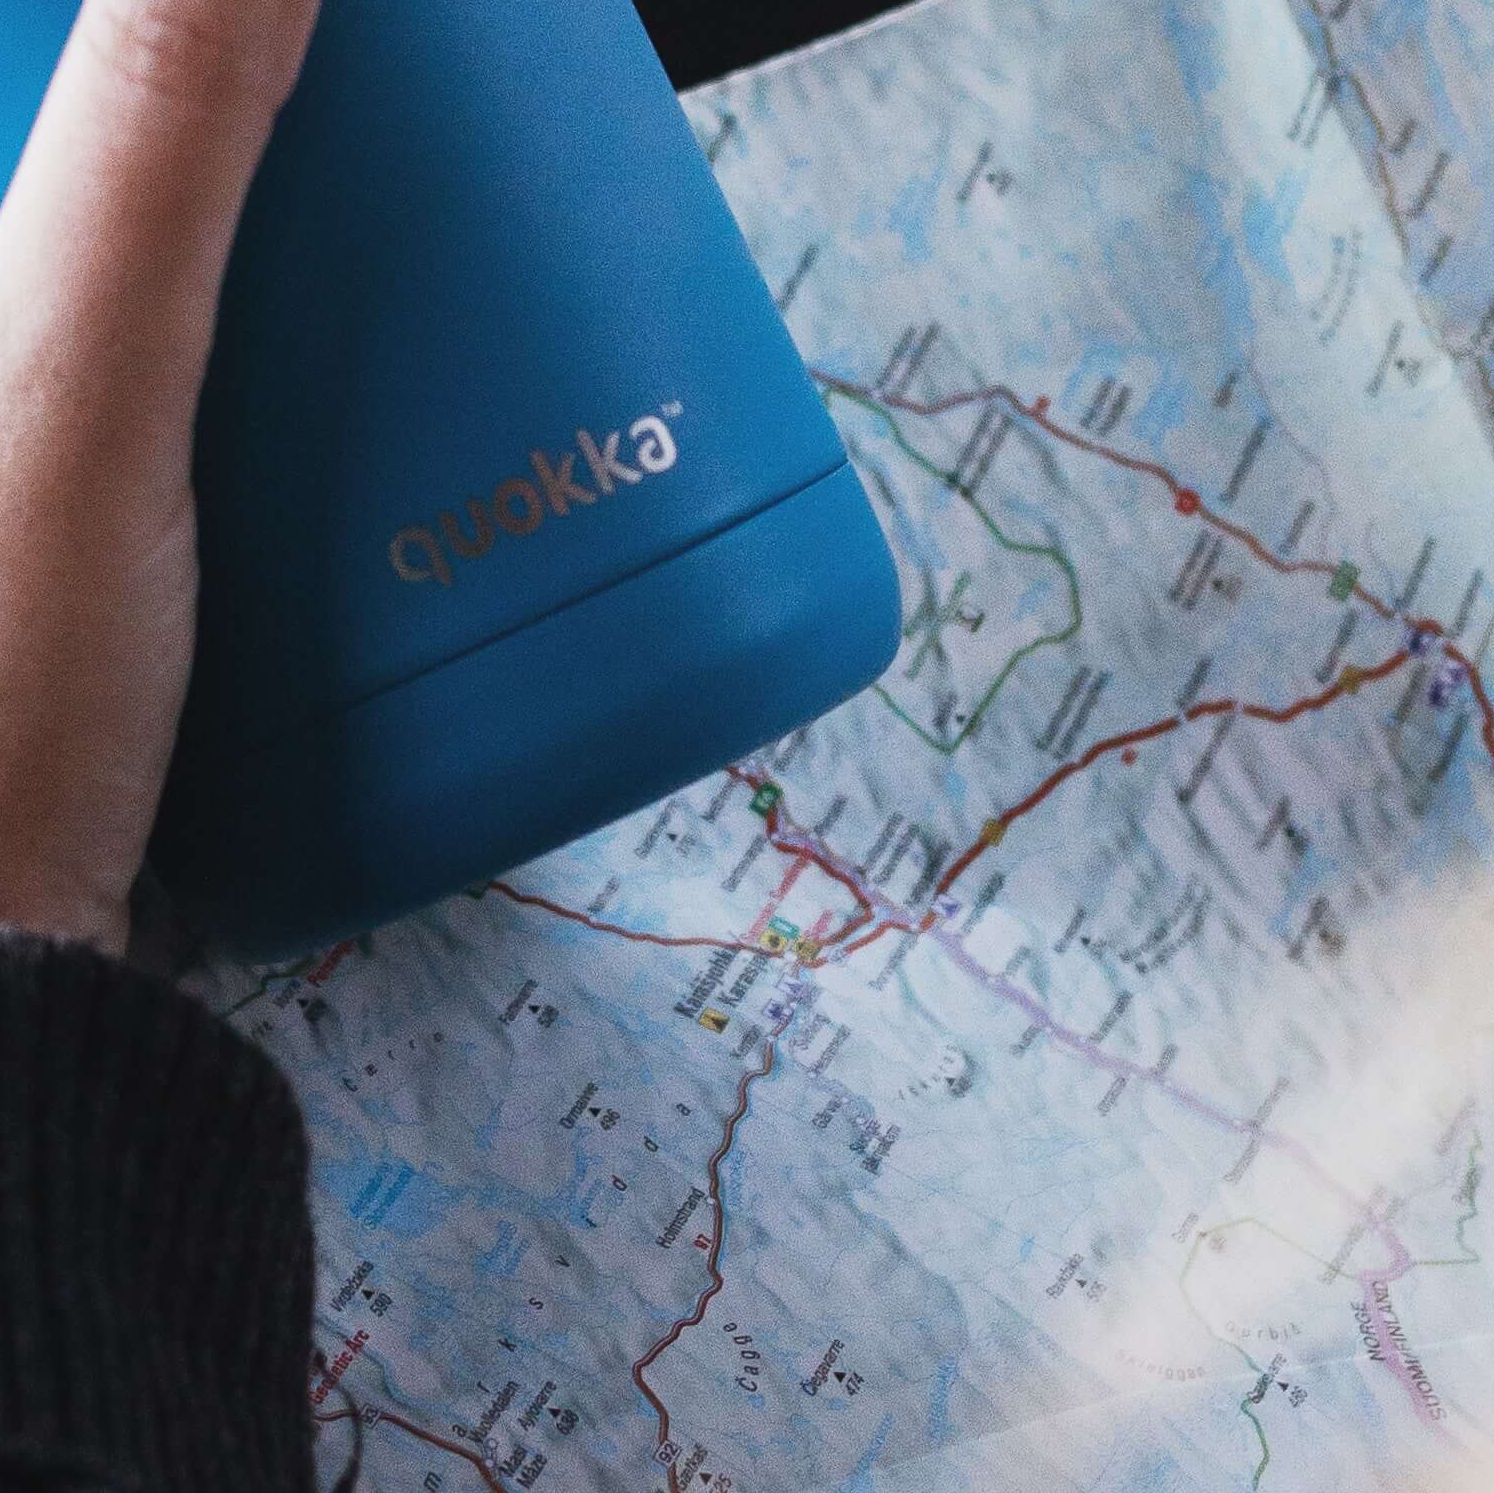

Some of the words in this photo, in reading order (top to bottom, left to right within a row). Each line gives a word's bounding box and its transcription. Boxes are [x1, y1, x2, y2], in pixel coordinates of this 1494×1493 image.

[388, 413, 675, 587] quokka
[655, 1187, 704, 1249] Holmstrand
[343, 1329, 369, 1354] Arc
[1349, 1302, 1387, 1363] NORGE
[659, 1442, 677, 1463] 92
